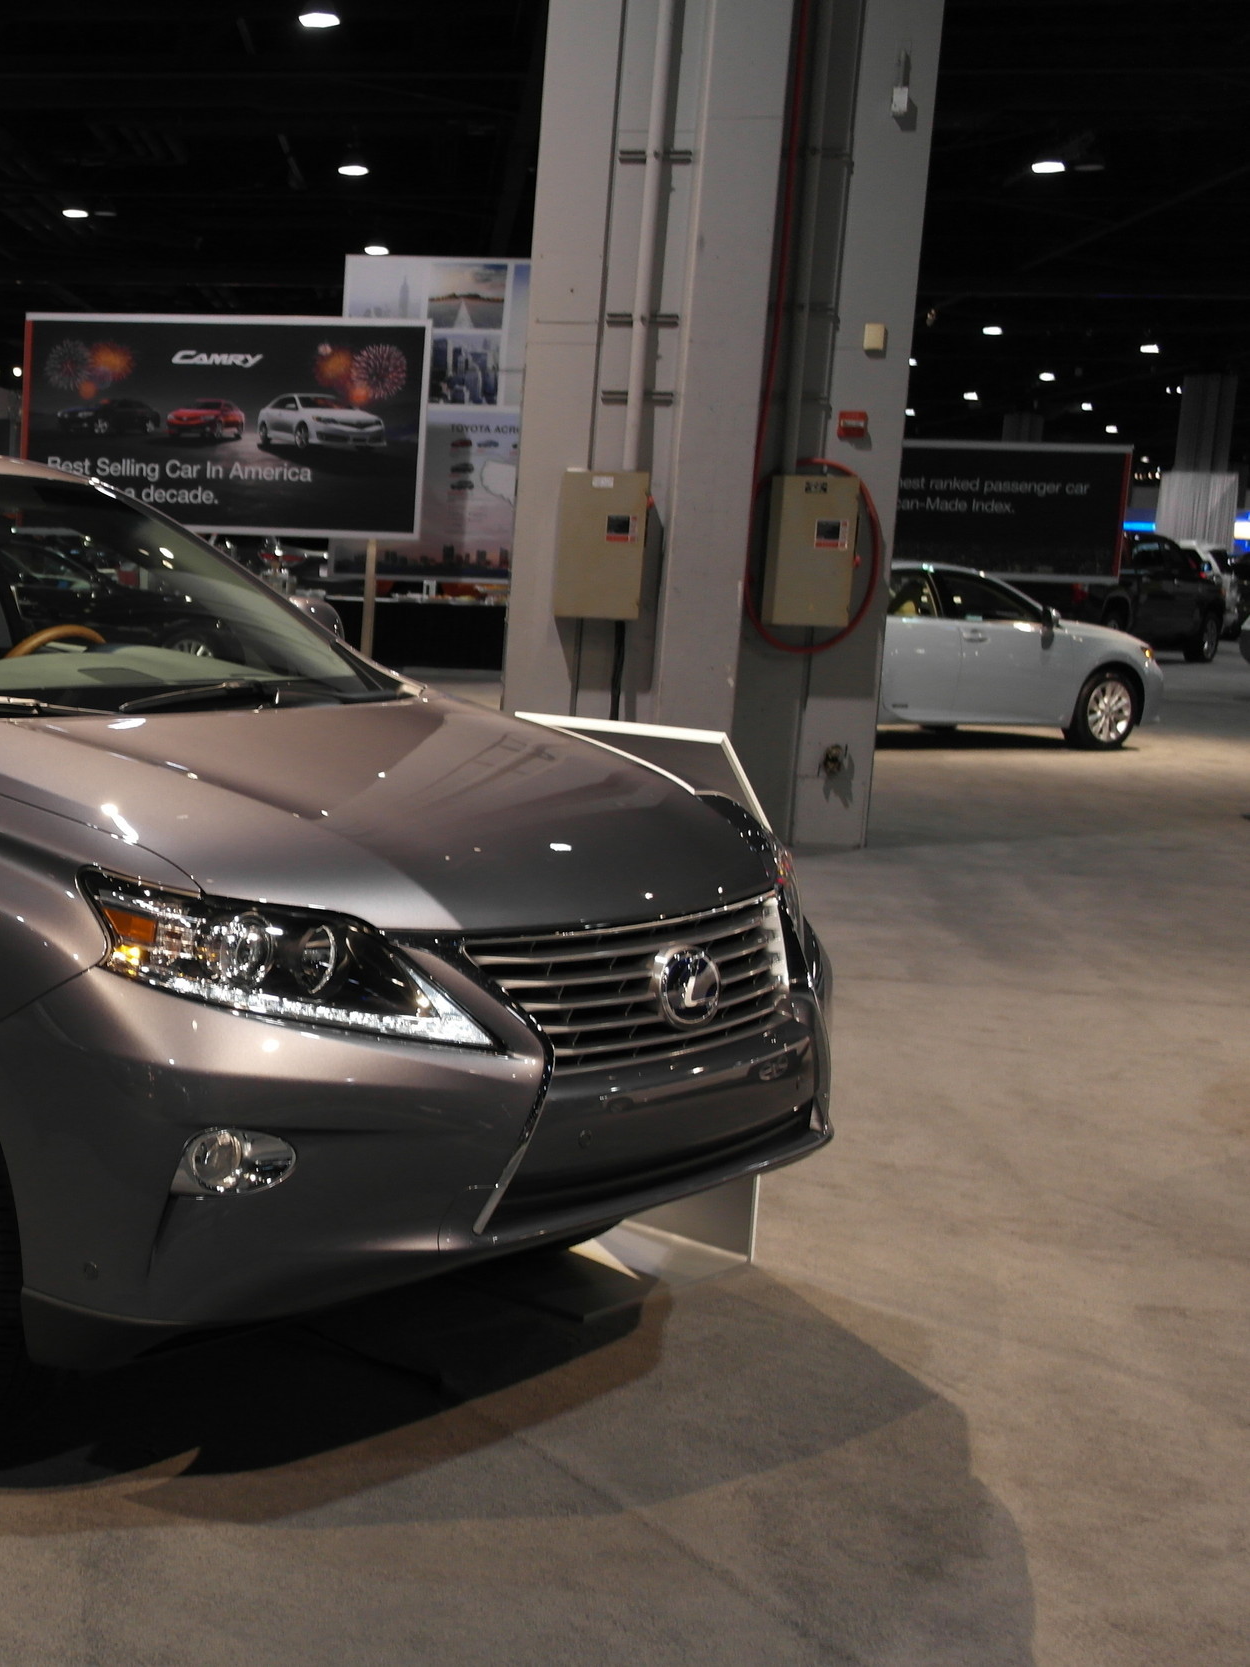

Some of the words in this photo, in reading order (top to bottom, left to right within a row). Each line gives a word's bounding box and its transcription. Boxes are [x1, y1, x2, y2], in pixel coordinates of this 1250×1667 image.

[171, 350, 264, 368] CAMRY
[450, 423, 491, 434] TOYOTA
[96, 457, 160, 482] Selling
[166, 459, 201, 479] Car
[207, 461, 224, 479] In
[229, 461, 312, 482] America
[141, 484, 219, 505] decade.
[930, 477, 980, 492] ranked
[983, 479, 1061, 497] passenger
[1065, 482, 1090, 495] car
[972, 498, 1015, 515] Index.
